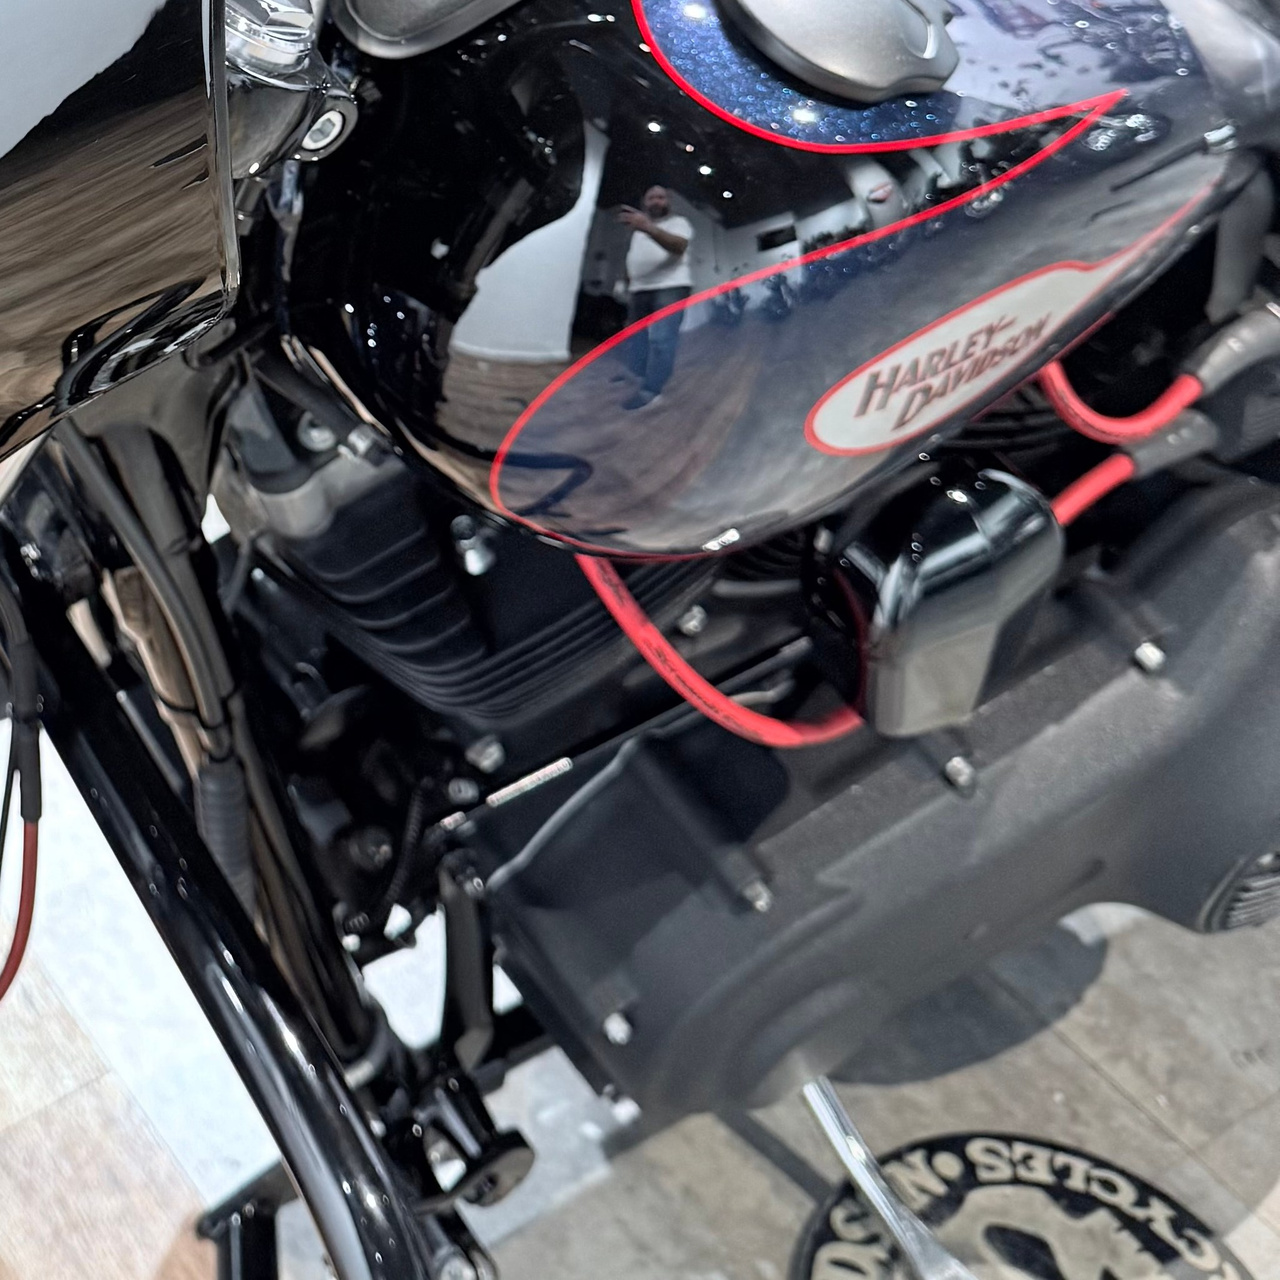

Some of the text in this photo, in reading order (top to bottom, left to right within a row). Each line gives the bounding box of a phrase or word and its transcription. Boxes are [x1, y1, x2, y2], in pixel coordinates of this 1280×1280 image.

[853, 314, 1019, 419] HARLEY-
[891, 311, 1053, 431] DAVIDSON
[965, 1136, 1242, 1280] CYCLES
